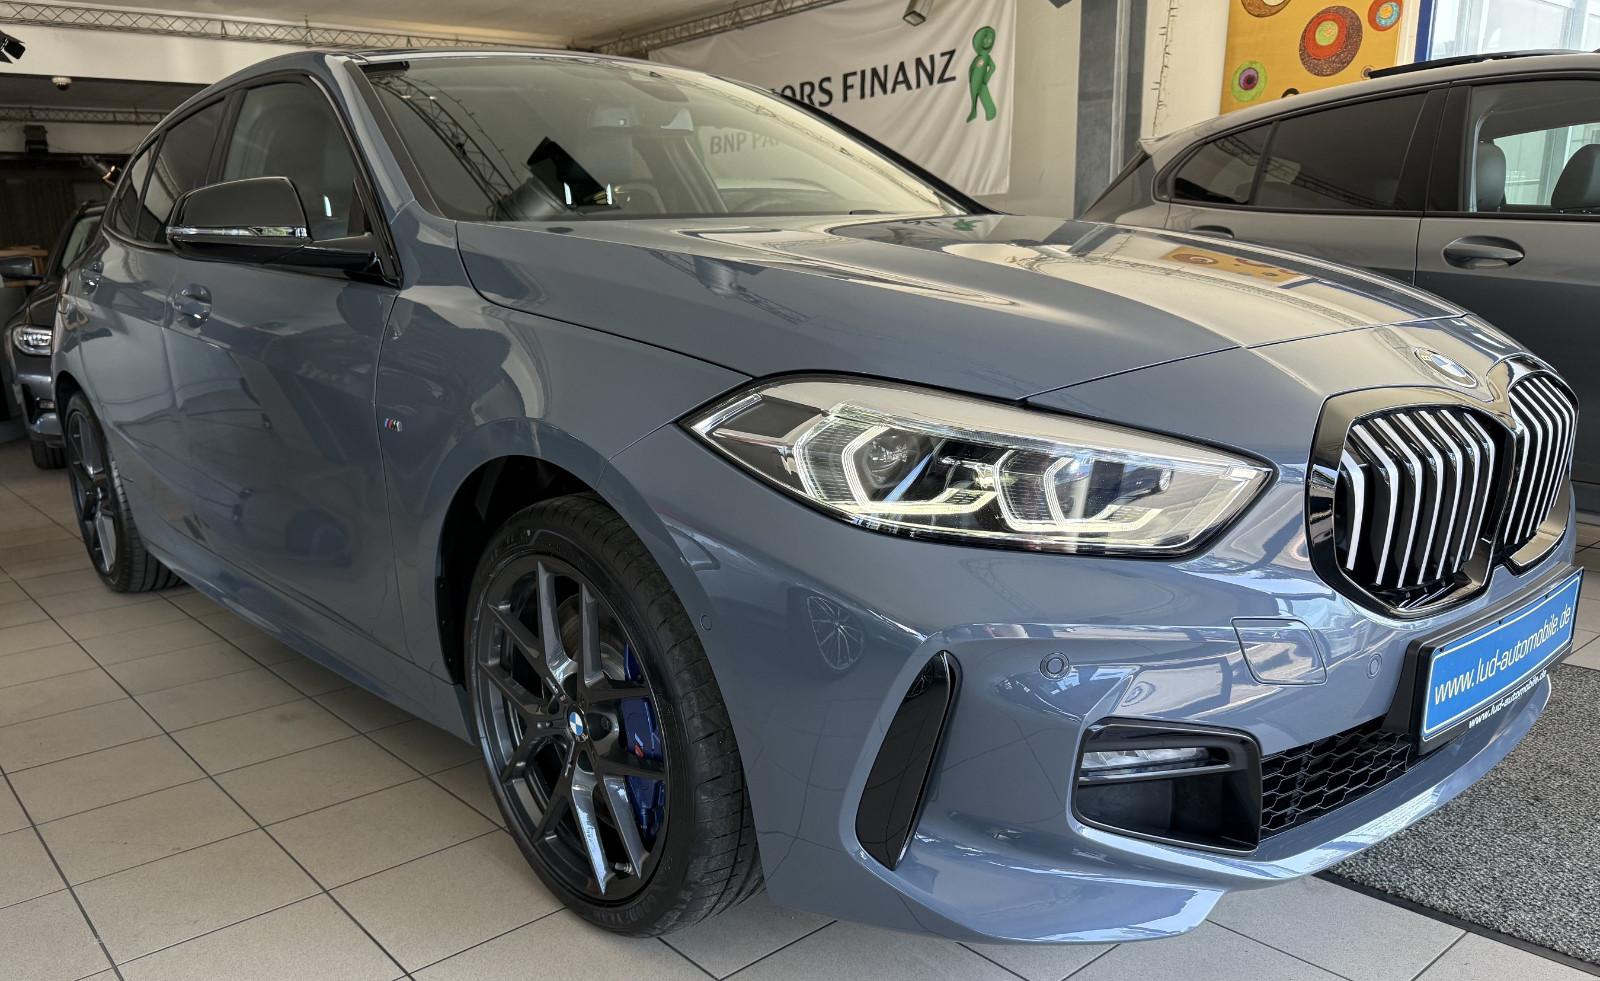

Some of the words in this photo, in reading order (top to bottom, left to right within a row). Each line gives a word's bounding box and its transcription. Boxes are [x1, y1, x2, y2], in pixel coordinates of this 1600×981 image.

[771, 77, 833, 107] ORS
[842, 48, 957, 103] FINANZ
[710, 132, 746, 155] BNP
[1434, 604, 1571, 704] www.lud-automobile.de
[1469, 670, 1546, 728] www.lud-automobile.de
